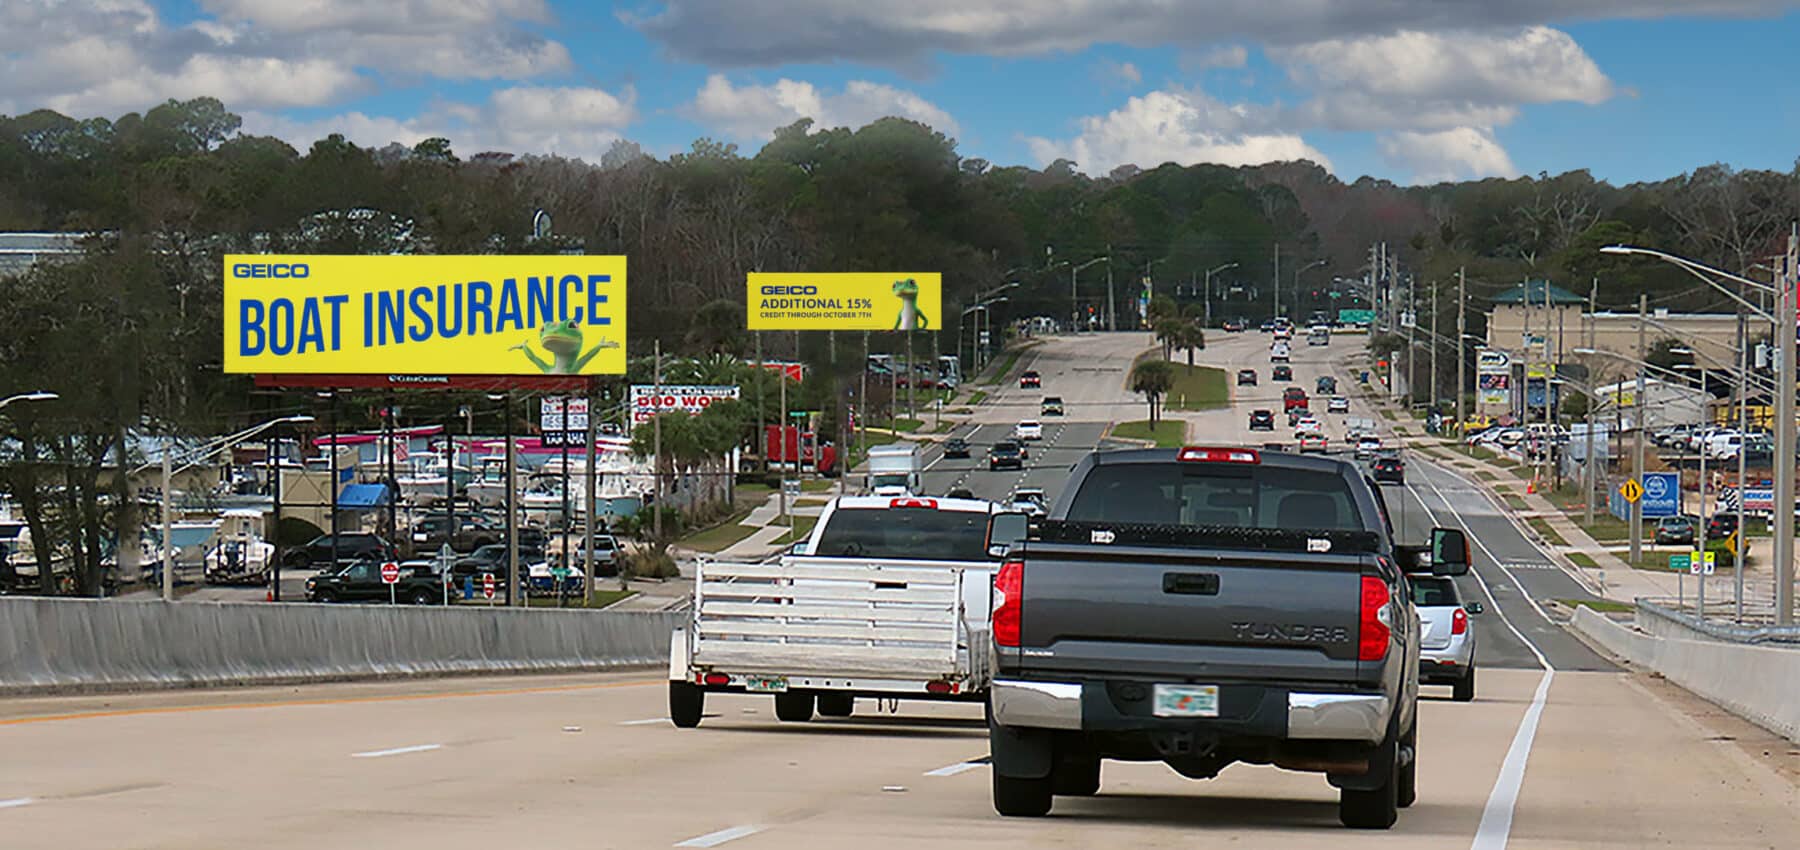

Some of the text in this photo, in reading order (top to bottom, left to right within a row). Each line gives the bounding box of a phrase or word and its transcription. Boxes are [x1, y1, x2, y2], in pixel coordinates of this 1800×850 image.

[233, 264, 309, 278] GEICO
[760, 285, 817, 296] GEICO
[760, 299, 872, 309] ADDITIONAL 15%
[240, 275, 611, 356] BOAT INSURANCE
[760, 311, 872, 319] CREDIT THROUGH OCTOBER 7TH
[1231, 622, 1350, 643] TUNDRA
